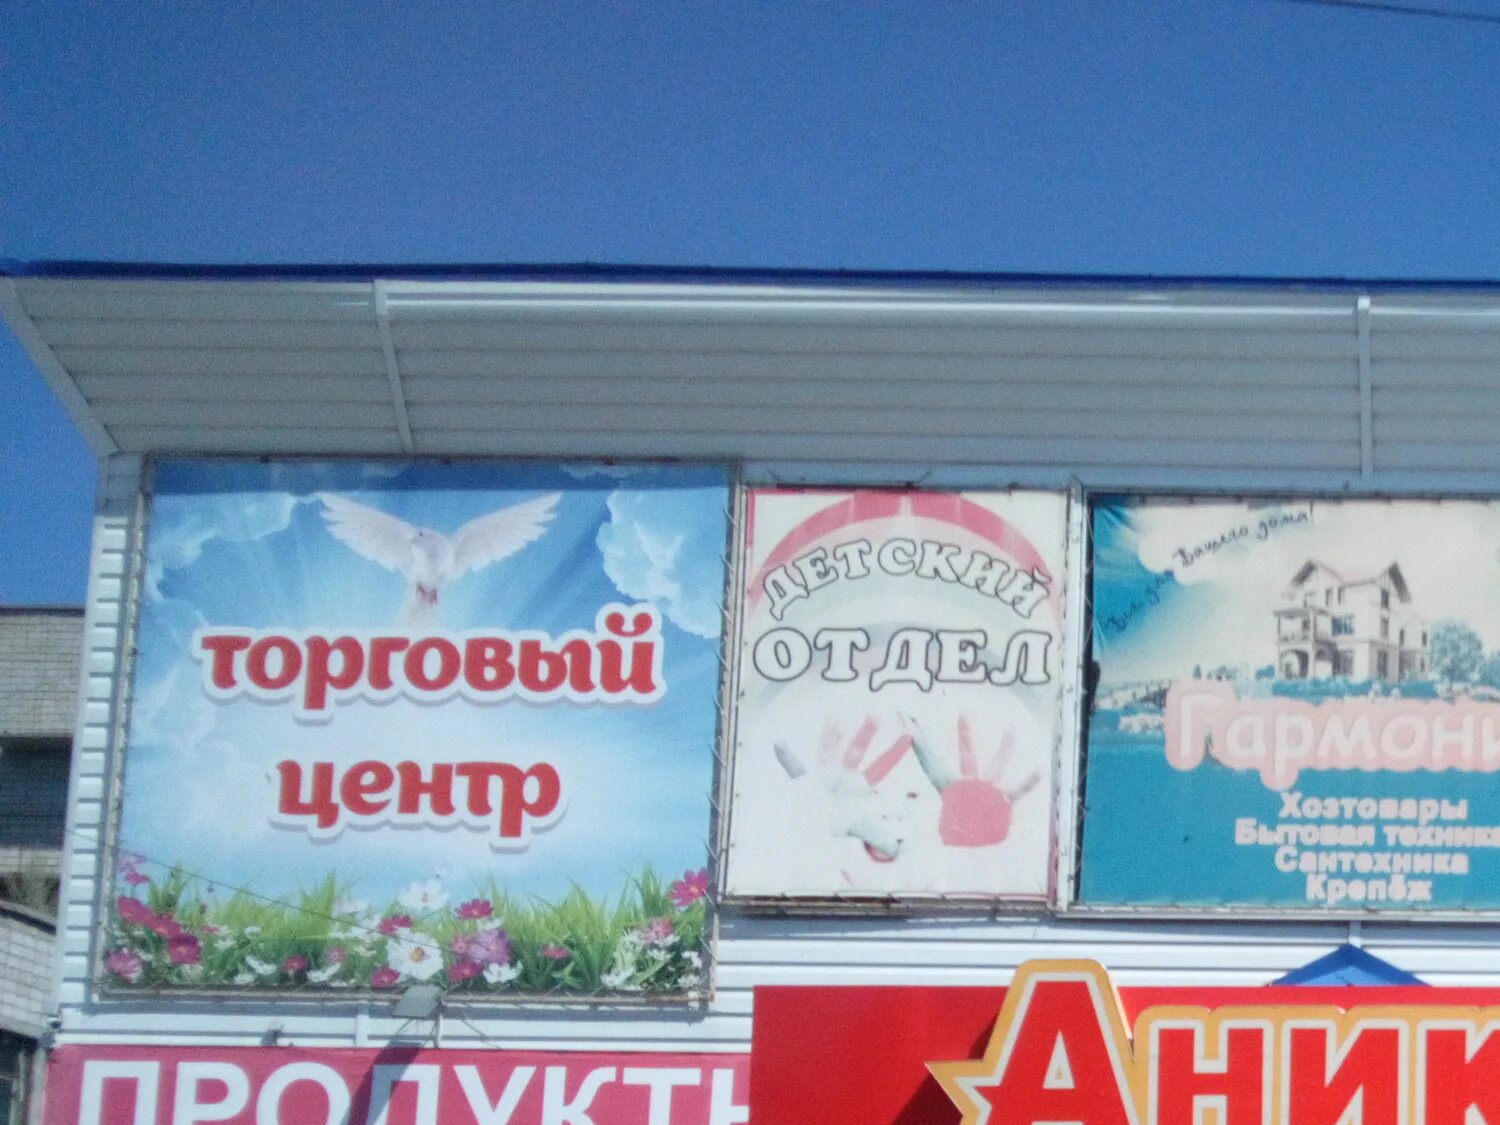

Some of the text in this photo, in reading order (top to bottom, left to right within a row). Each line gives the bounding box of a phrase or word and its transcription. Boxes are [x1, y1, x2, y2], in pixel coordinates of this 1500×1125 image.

[762, 537, 1050, 620] ДЕТСКИЙ
[753, 628, 1052, 691] ОТДЕЛ
[276, 759, 561, 838] центр
[1279, 791, 1469, 826] Хозтовары
[1234, 817, 1376, 846] Бытовая
[1275, 846, 1470, 875] Сантехника
